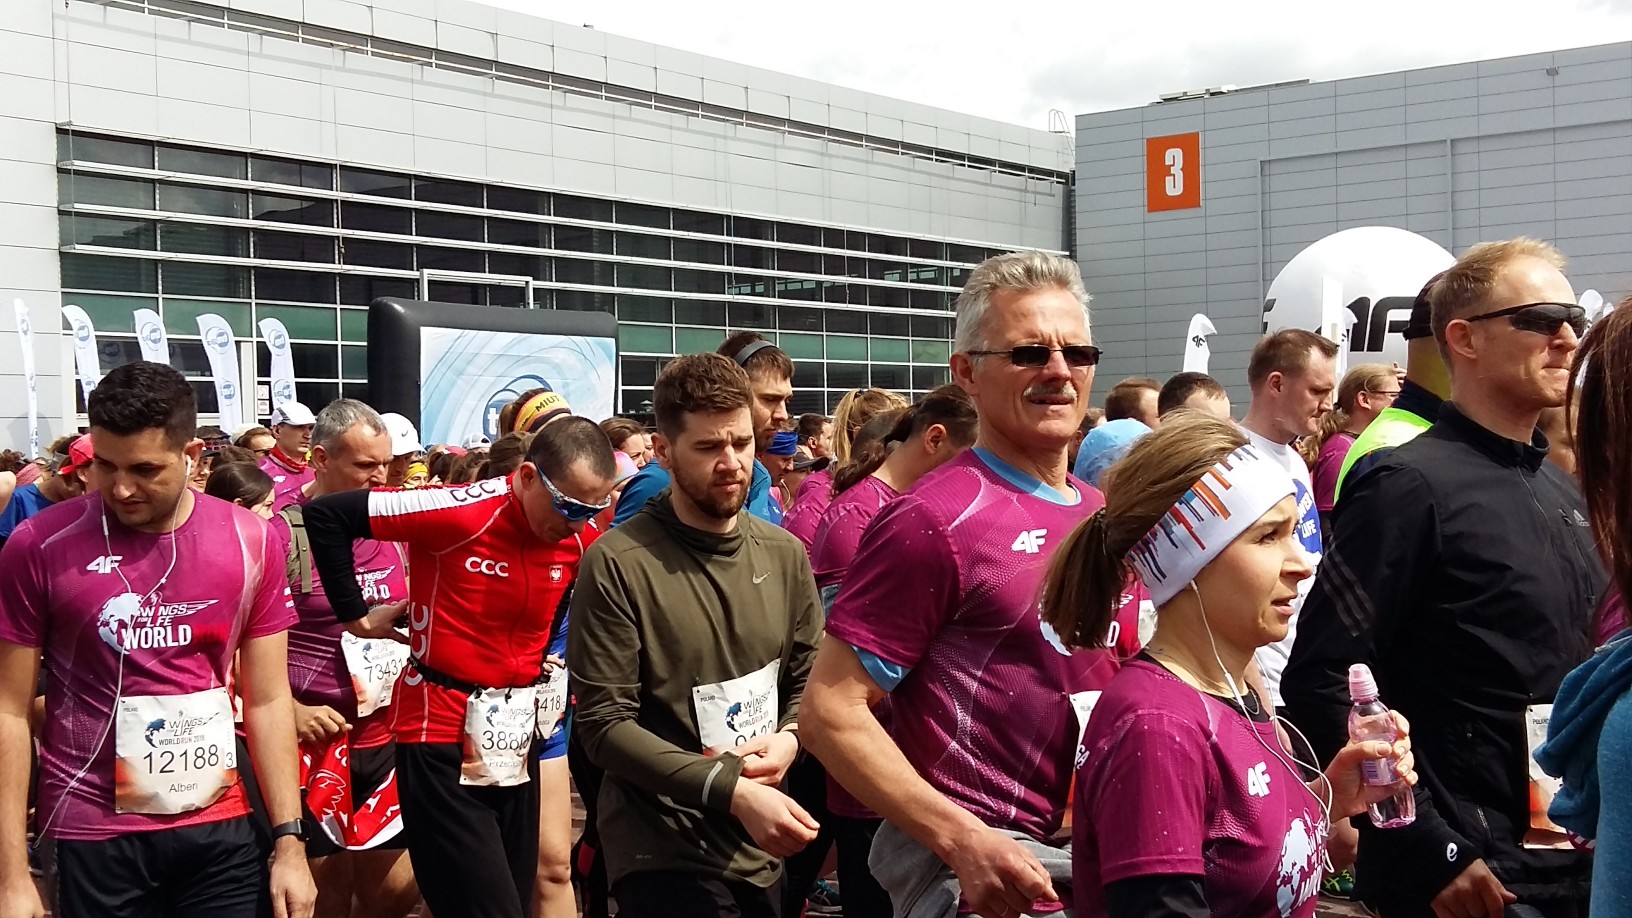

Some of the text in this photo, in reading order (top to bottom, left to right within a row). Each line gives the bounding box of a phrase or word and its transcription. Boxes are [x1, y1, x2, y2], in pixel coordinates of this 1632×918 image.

[1165, 148, 1183, 196] 3
[449, 481, 496, 502] CCC
[1012, 529, 1047, 553] 4F
[86, 555, 123, 574] 4F
[465, 556, 509, 577] CCC
[121, 624, 192, 650] WORLD
[169, 718, 203, 729] WINGS
[158, 737, 180, 746] WORLD
[143, 744, 234, 775] 12188 3
[1247, 761, 1271, 798] 4F
[1446, 842, 1458, 862] e
